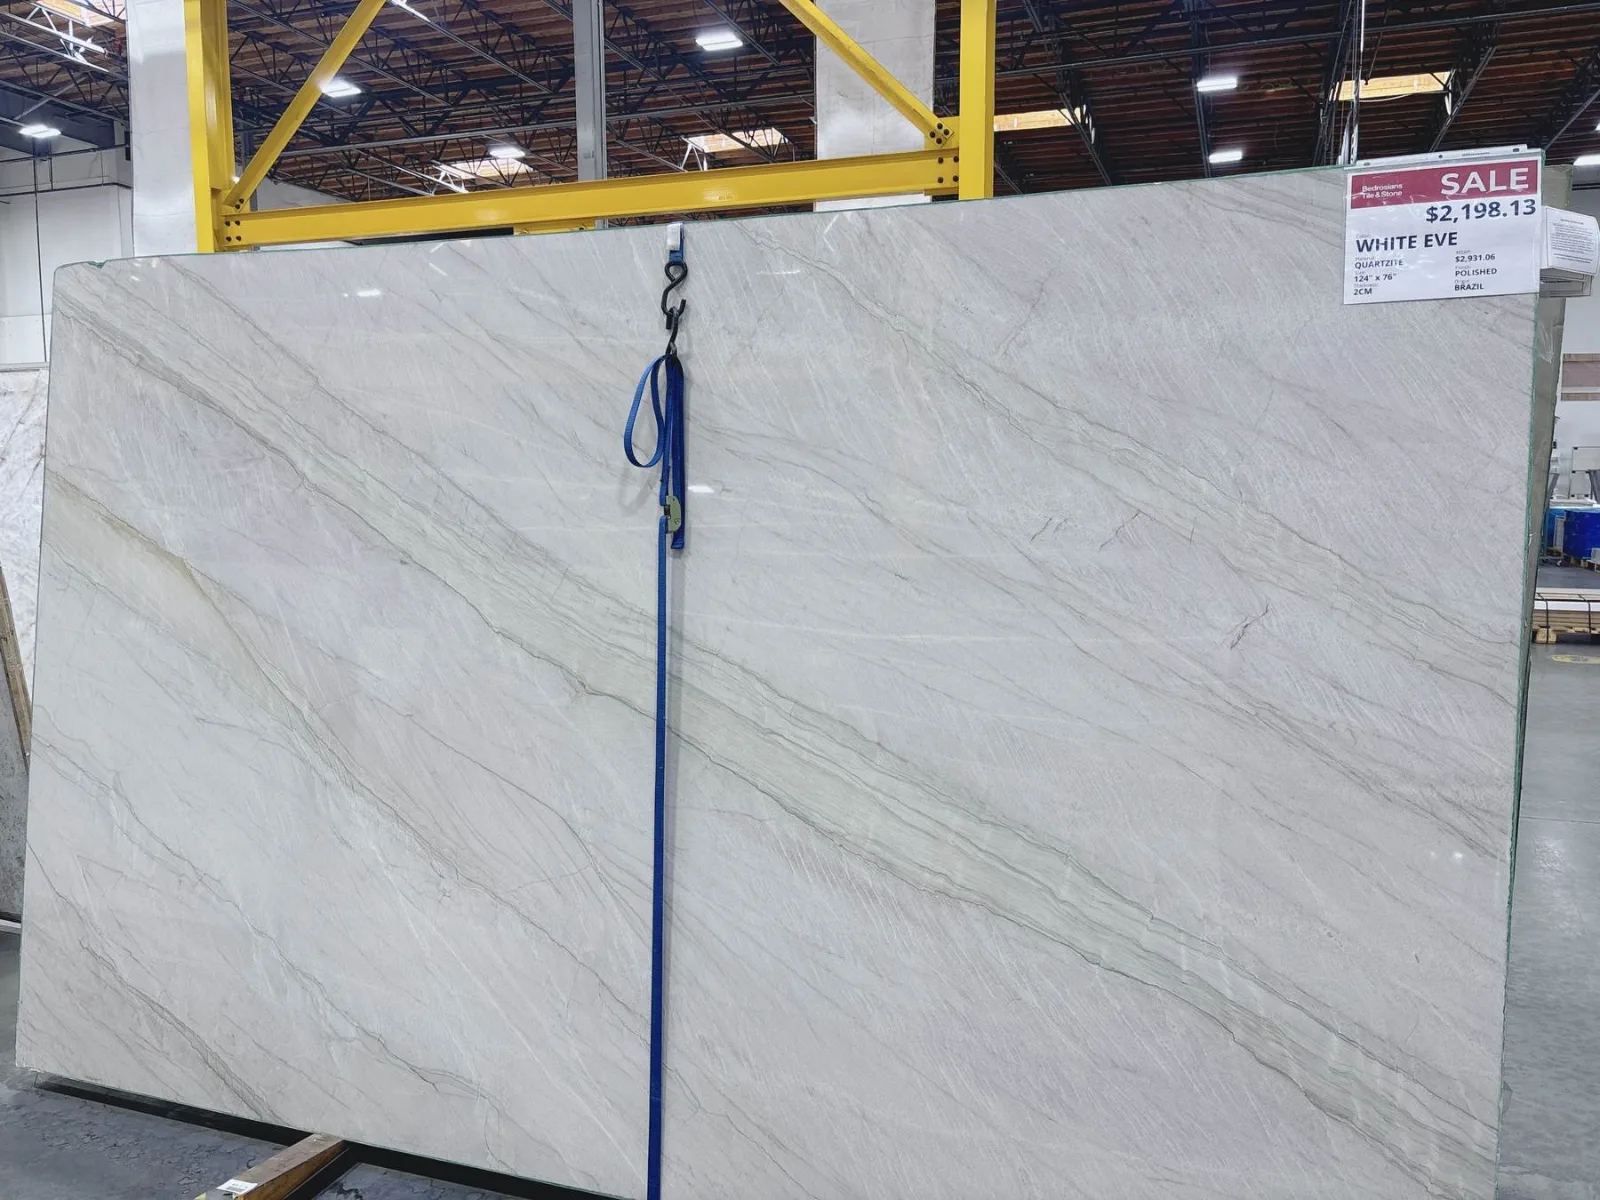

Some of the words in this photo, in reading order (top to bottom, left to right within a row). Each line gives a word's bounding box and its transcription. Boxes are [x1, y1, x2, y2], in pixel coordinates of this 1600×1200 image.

[1440, 167, 1529, 196] SALE
[1362, 183, 1403, 192] Bedrosians
[1381, 190, 1403, 198] Stone
[1426, 198, 1537, 224] $2,198.13
[1356, 235, 1418, 253] WHITE
[1424, 231, 1458, 248] EVE
[1455, 253, 1496, 263] $2,931.06
[1355, 259, 1404, 270] QUARTZITE
[1383, 273, 1397, 281] 76"
[1455, 267, 1498, 277] POLISHED
[1353, 288, 1373, 296] 2CM
[1454, 283, 1485, 291] BRAZIL
